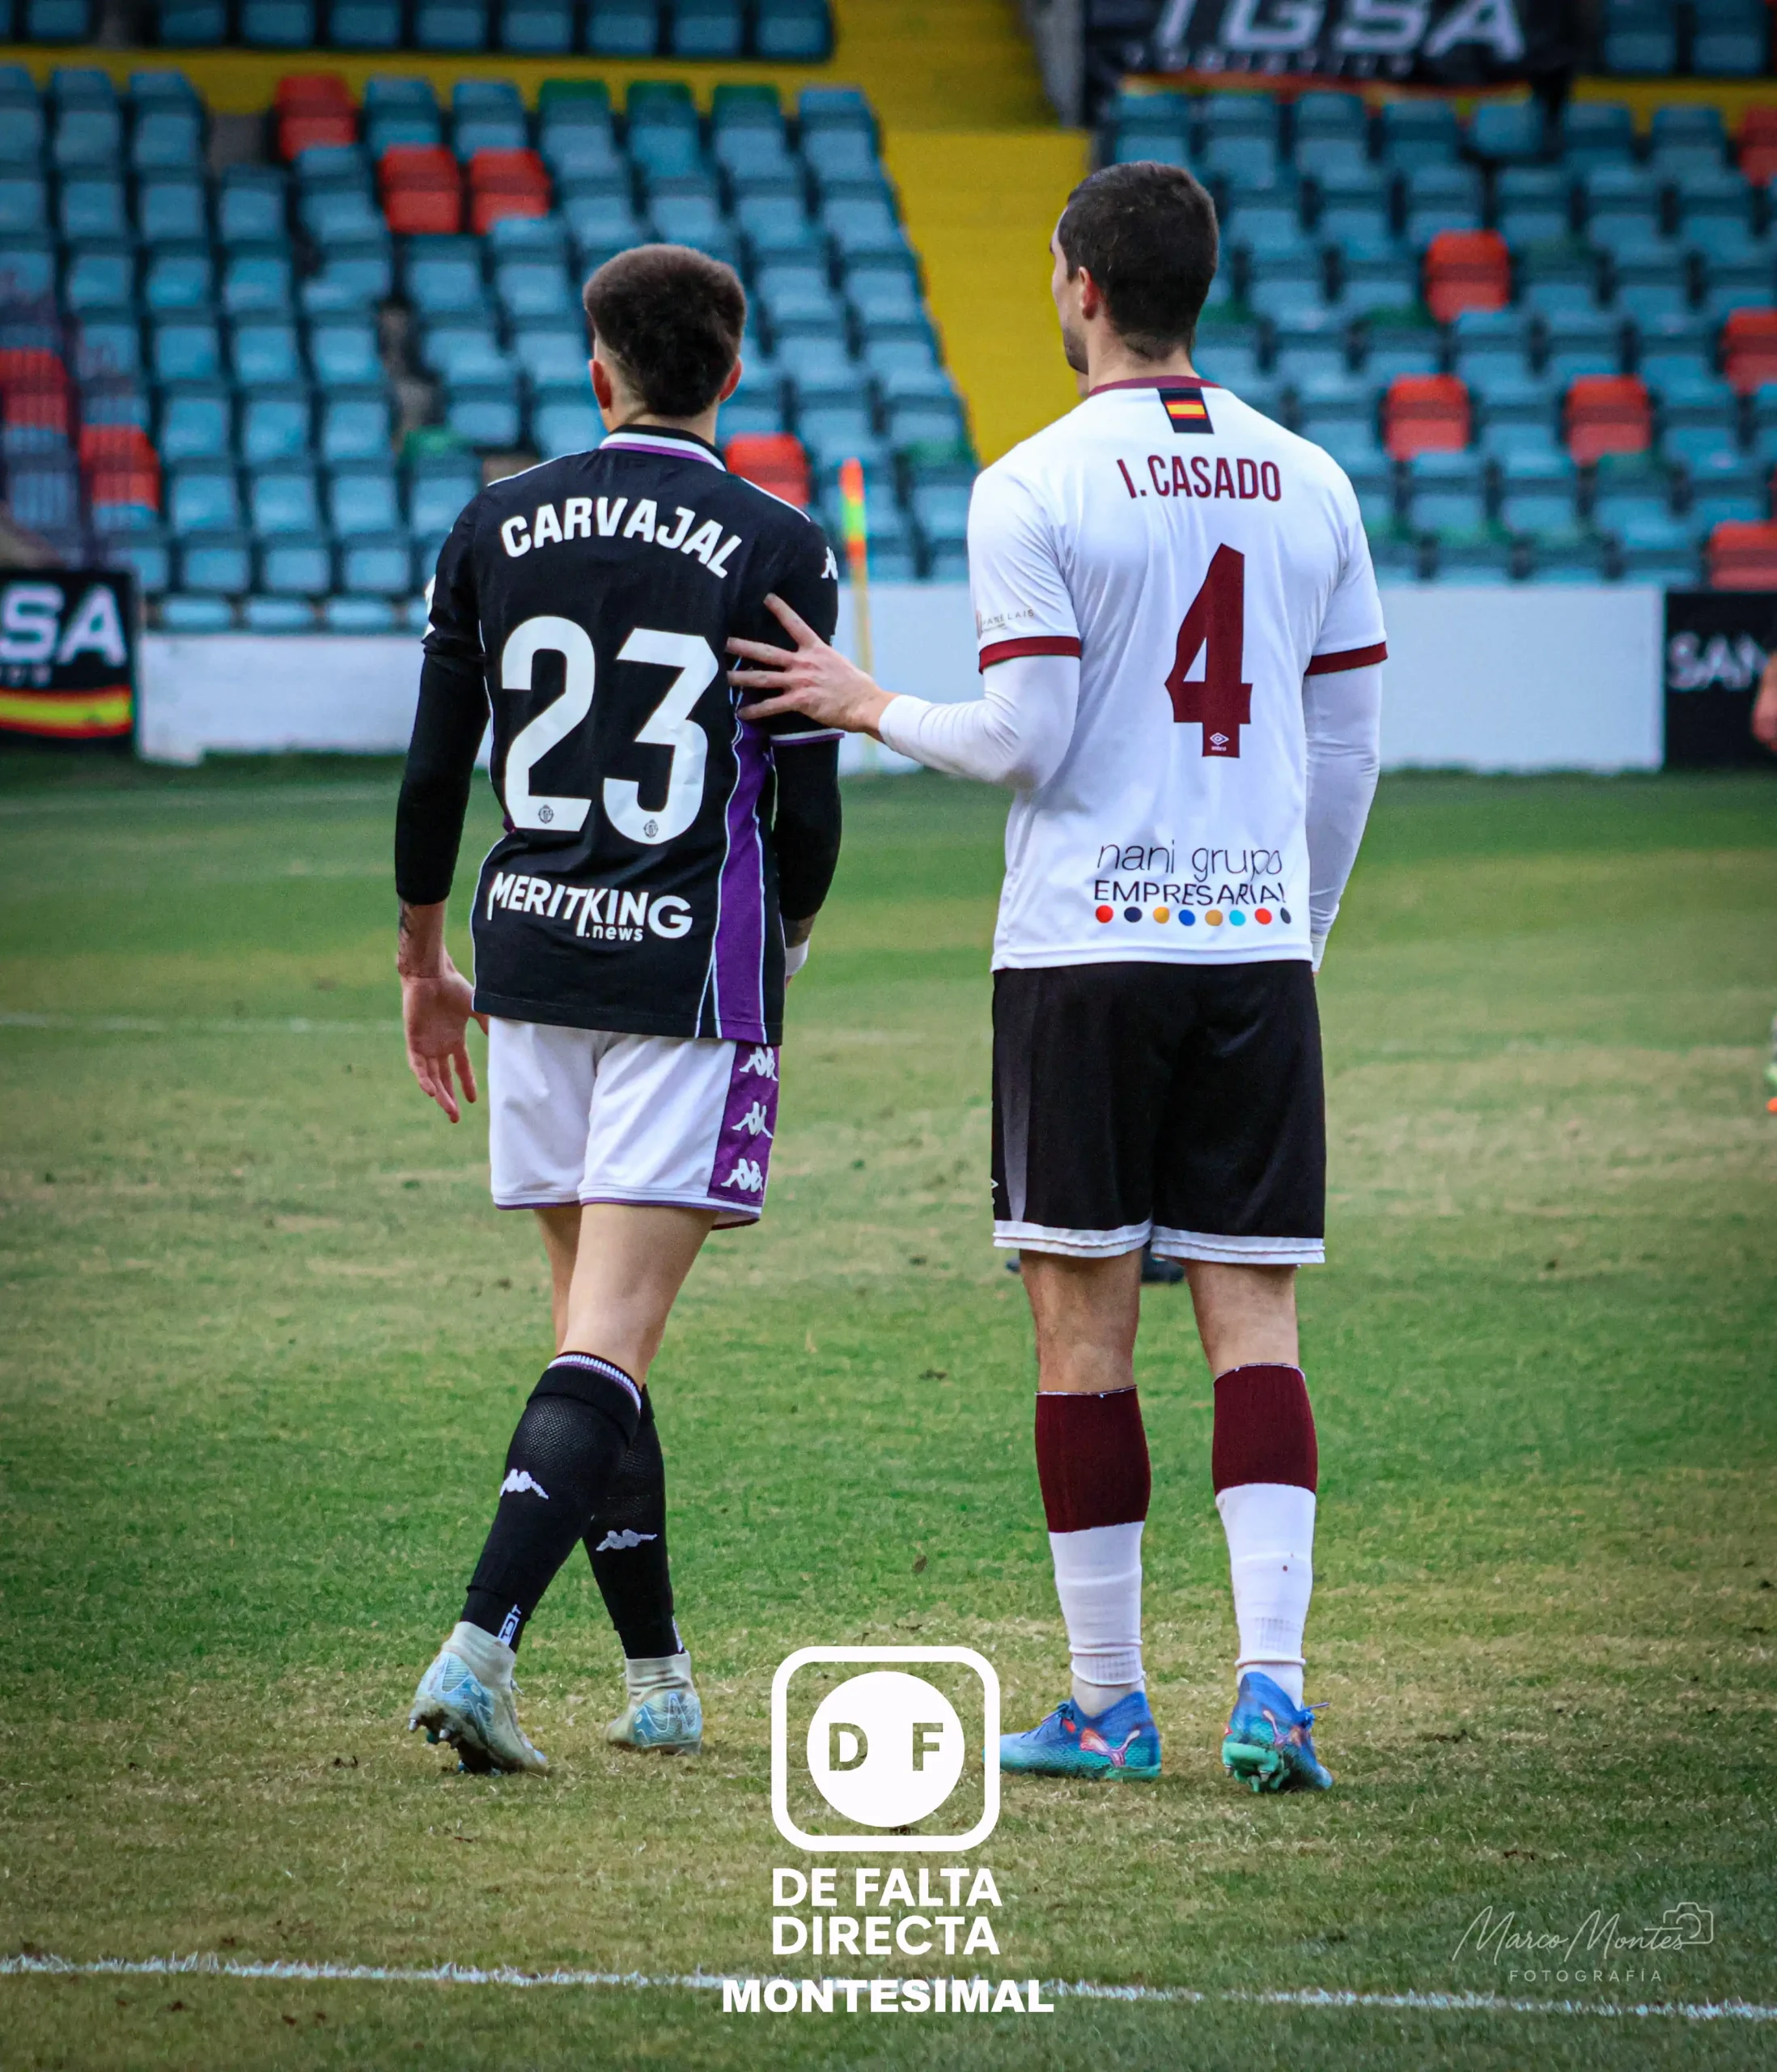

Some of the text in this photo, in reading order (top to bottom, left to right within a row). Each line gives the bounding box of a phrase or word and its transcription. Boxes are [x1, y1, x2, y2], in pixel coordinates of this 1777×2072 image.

[500, 496, 743, 580] CARVAJAL
[1164, 543, 1253, 758] 4
[502, 615, 719, 845] 23
[1096, 839, 1283, 883] nani grupo
[487, 871, 693, 939] MERITKING
